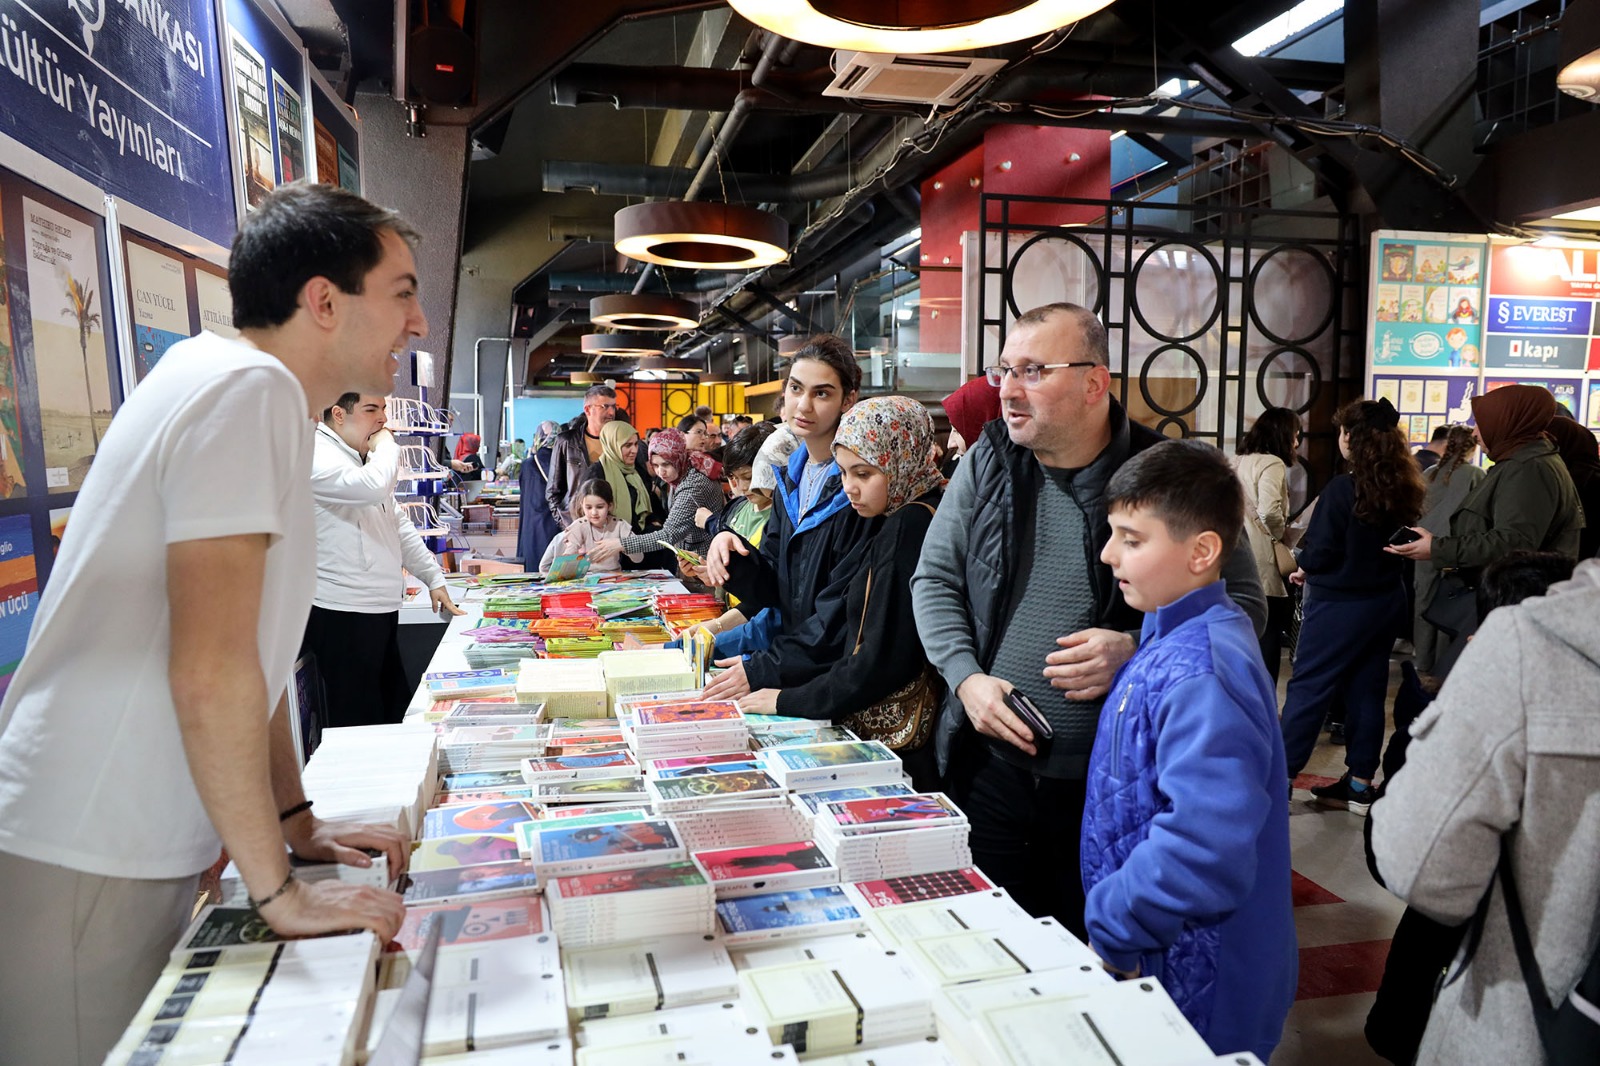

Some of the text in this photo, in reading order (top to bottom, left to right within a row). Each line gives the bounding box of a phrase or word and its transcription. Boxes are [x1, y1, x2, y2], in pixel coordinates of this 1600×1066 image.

[0, 13, 184, 182] ültür Yayınları
[136, 289, 176, 312] CAN YÜCEL
[1523, 340, 1558, 362] kapı
[1554, 386, 1575, 395] ATLAS
[8, 591, 28, 616] ÜÇÜ
